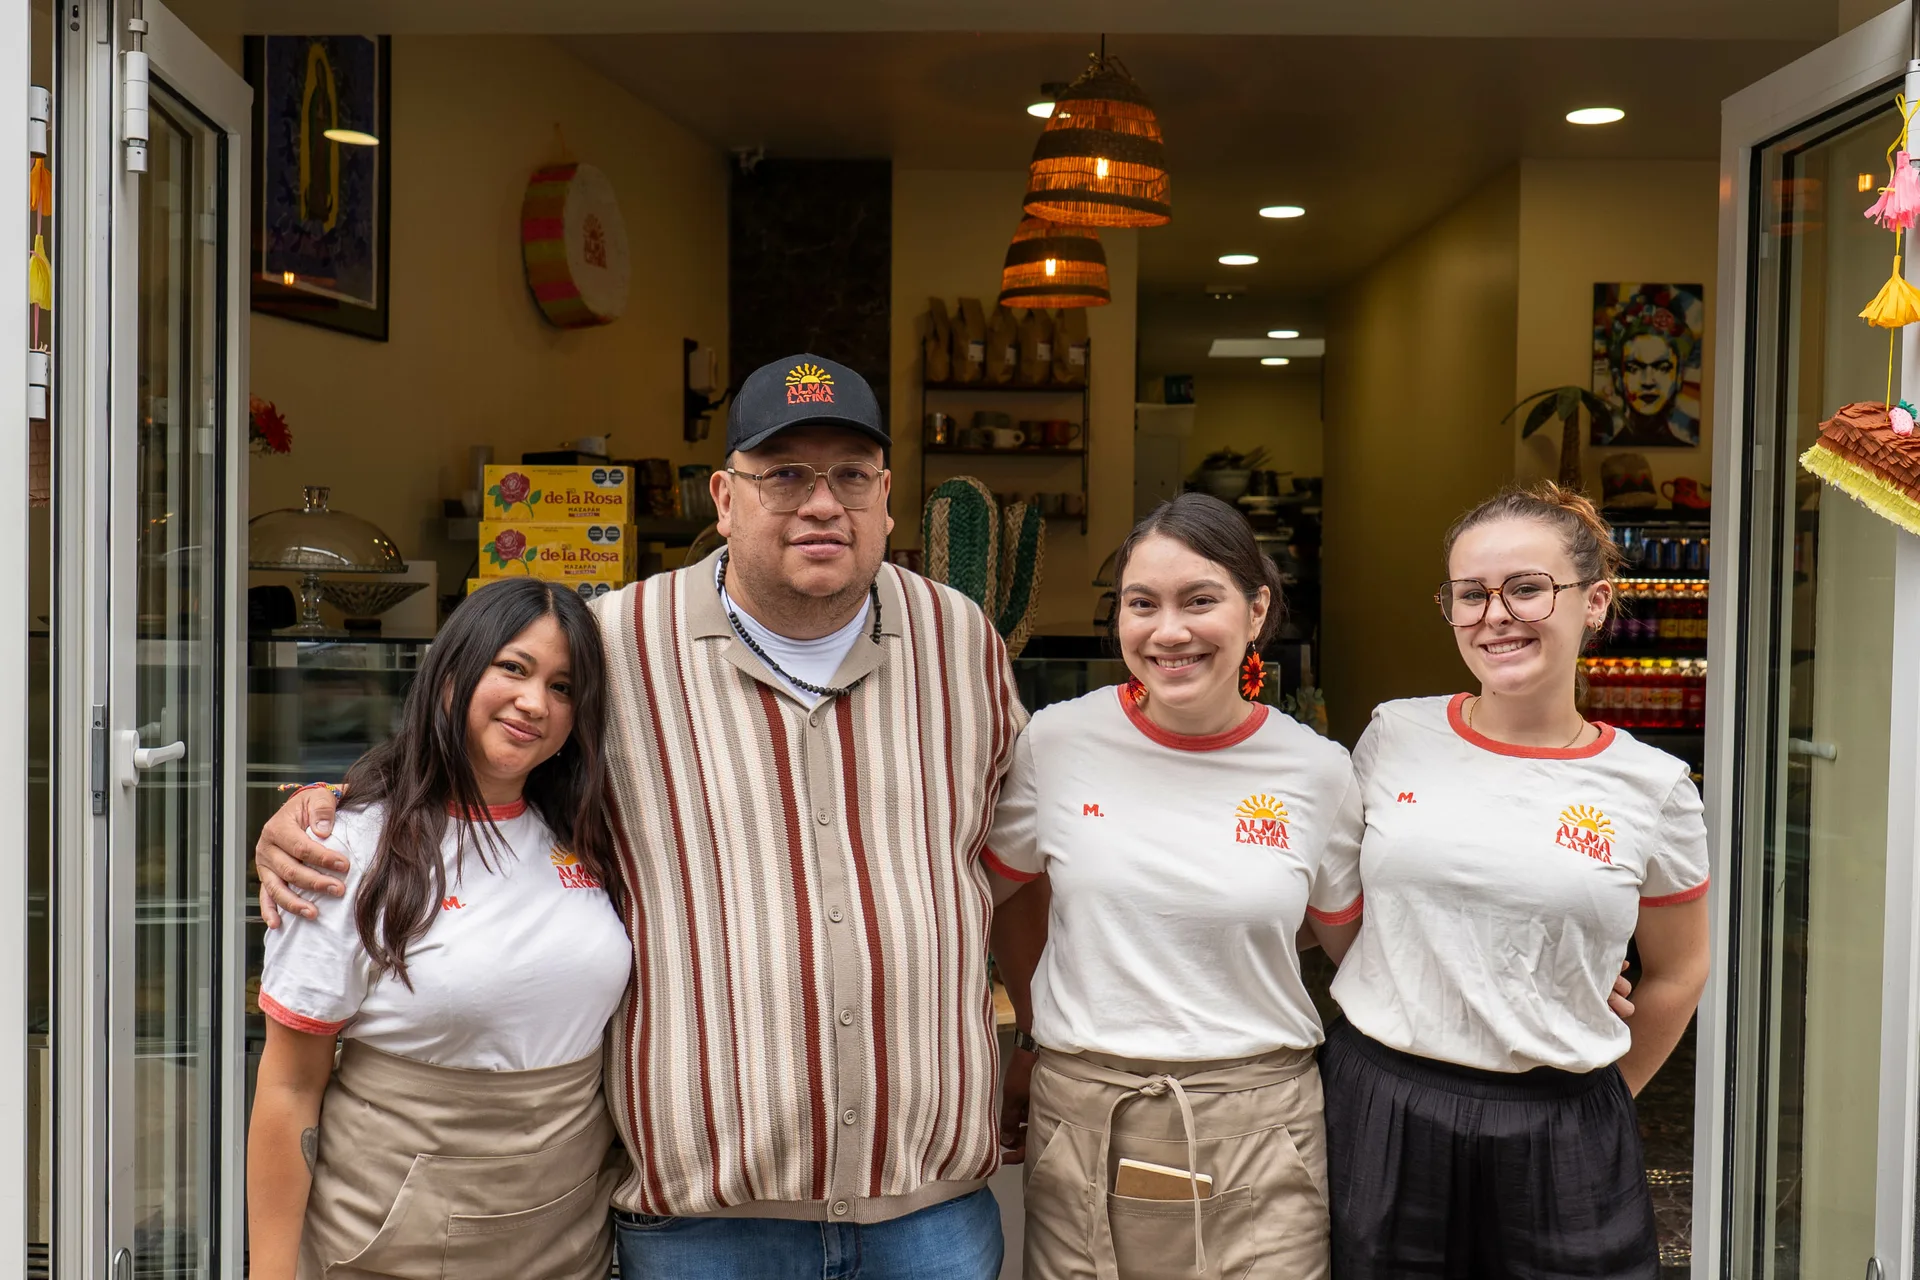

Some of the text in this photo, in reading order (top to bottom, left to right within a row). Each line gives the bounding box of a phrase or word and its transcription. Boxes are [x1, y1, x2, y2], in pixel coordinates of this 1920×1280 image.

[787, 383, 834, 396] ALMA
[787, 394, 835, 404] LATINA
[544, 491, 623, 505] de la Rosa
[541, 548, 619, 562] de la Rosa
[1397, 792, 1417, 804] M.
[1083, 804, 1104, 817] M.
[1236, 818, 1290, 839] ALMA
[1236, 832, 1291, 850] LATINA
[1556, 823, 1612, 857] ALMA
[1555, 834, 1613, 866] LATINA
[442, 895, 467, 911] M.
